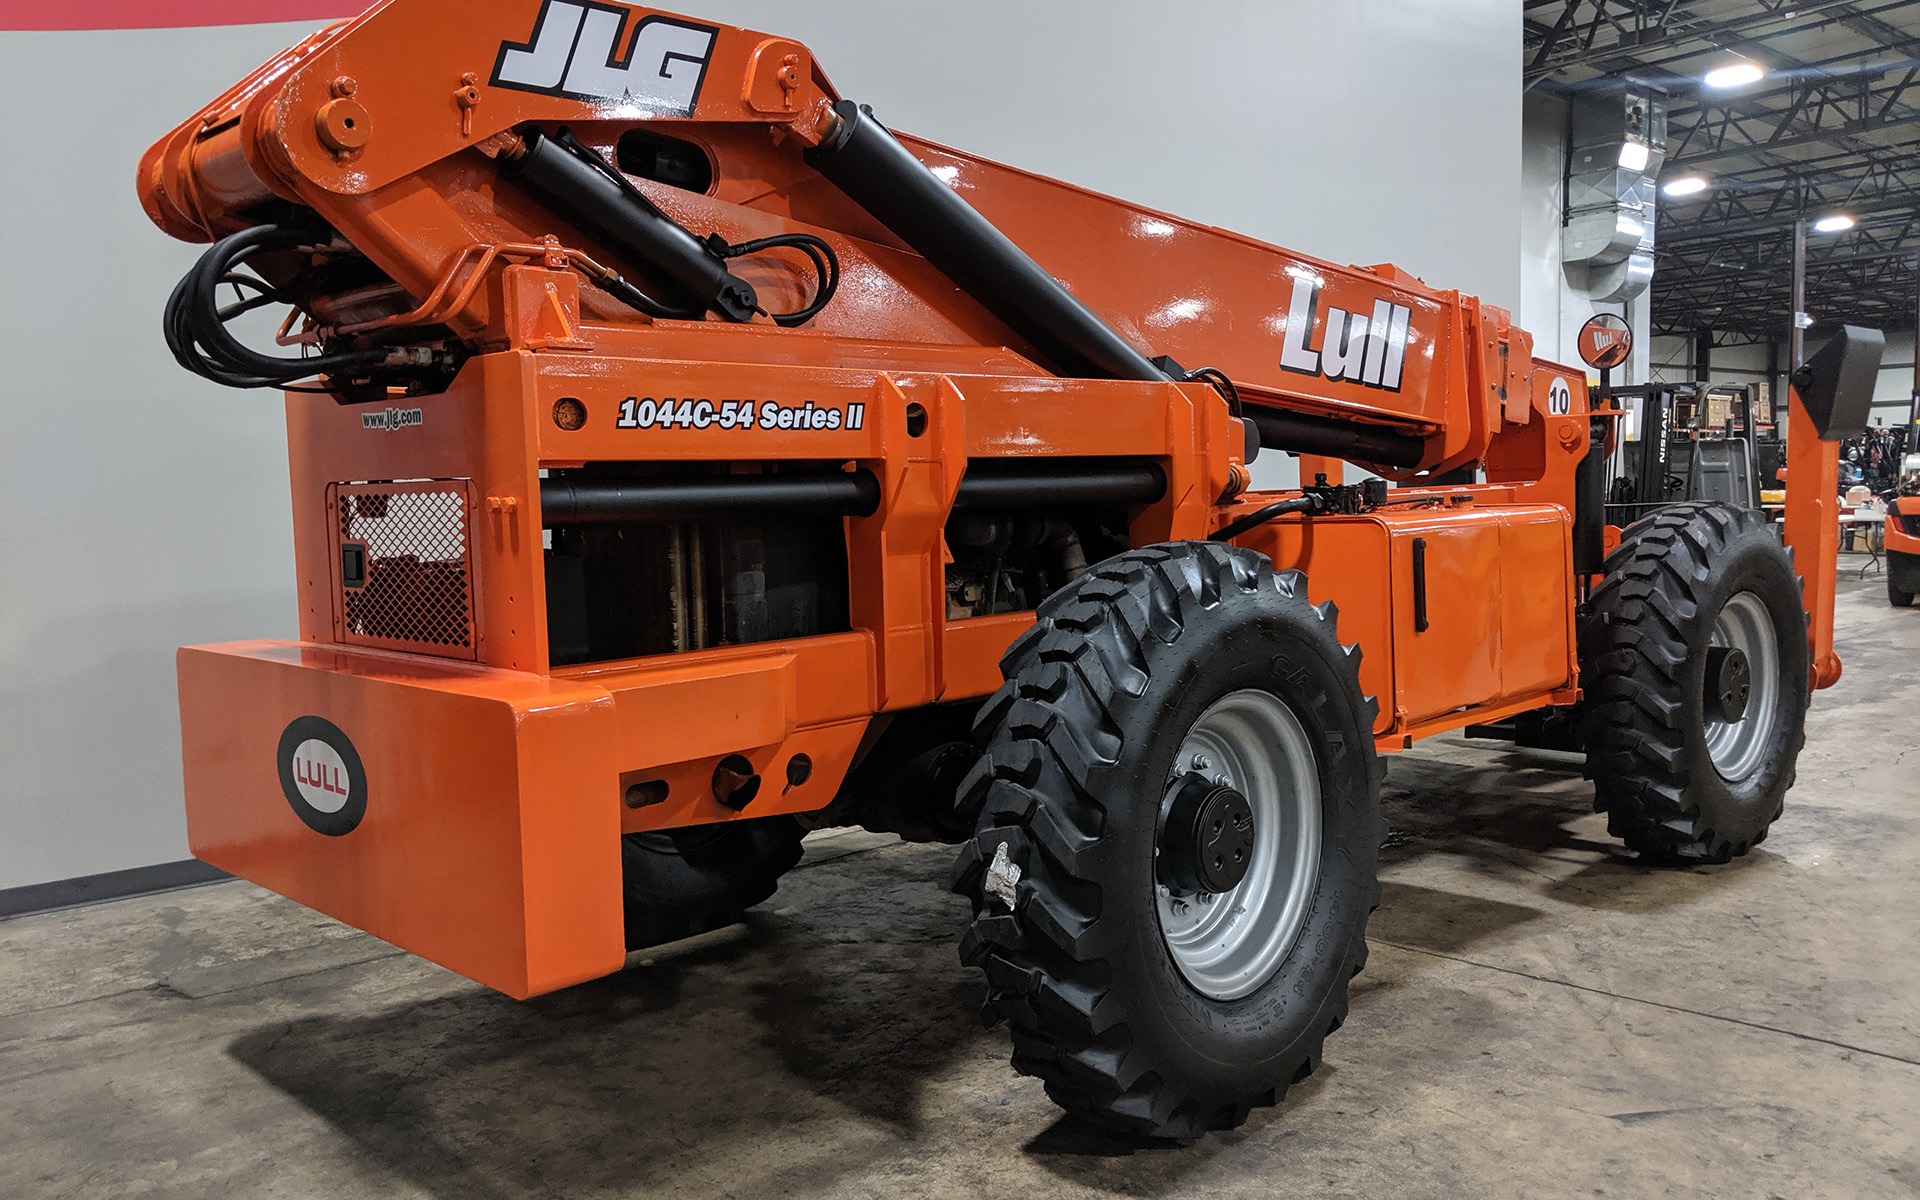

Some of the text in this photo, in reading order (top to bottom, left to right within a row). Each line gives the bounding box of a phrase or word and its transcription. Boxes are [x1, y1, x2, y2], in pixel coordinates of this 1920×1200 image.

[489, 0, 719, 117] JLG
[1280, 276, 1411, 392] Lull
[362, 407, 422, 431] www.jlg.com
[616, 397, 865, 430] 1044C-54 Series II
[1550, 386, 1569, 415] 10
[1659, 407, 1669, 463] NISSAN
[296, 756, 347, 796] LULL
